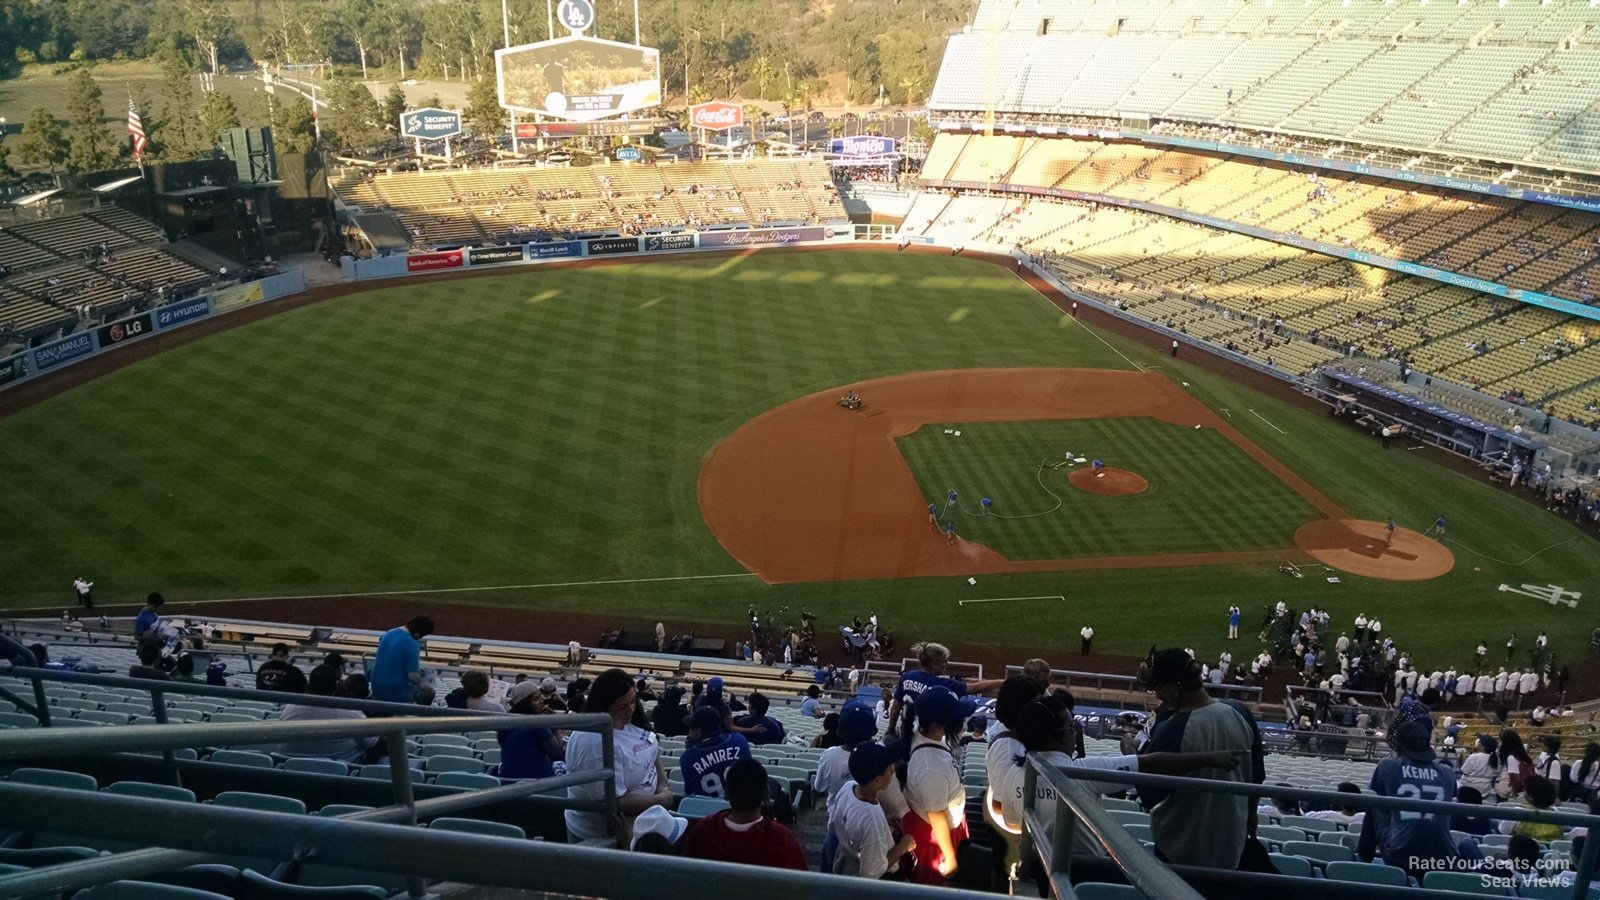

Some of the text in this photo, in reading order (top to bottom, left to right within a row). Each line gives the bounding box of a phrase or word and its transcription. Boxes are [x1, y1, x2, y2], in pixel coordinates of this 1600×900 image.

[1446, 179, 1471, 191] Donate
[1471, 182, 1490, 193] Now!
[738, 232, 769, 244] Angeles
[769, 230, 801, 243] Dodgers
[476, 250, 522, 260] Time Warner Cable
[1451, 275, 1477, 288] Donate
[1478, 281, 1498, 293] Now!
[173, 302, 208, 319] HYUNDAI
[125, 321, 142, 335] LG
[36, 348, 54, 361] SAN
[58, 336, 91, 353] MANUEL
[693, 746, 740, 774] RAMIREZ
[1401, 765, 1438, 780] KEMP
